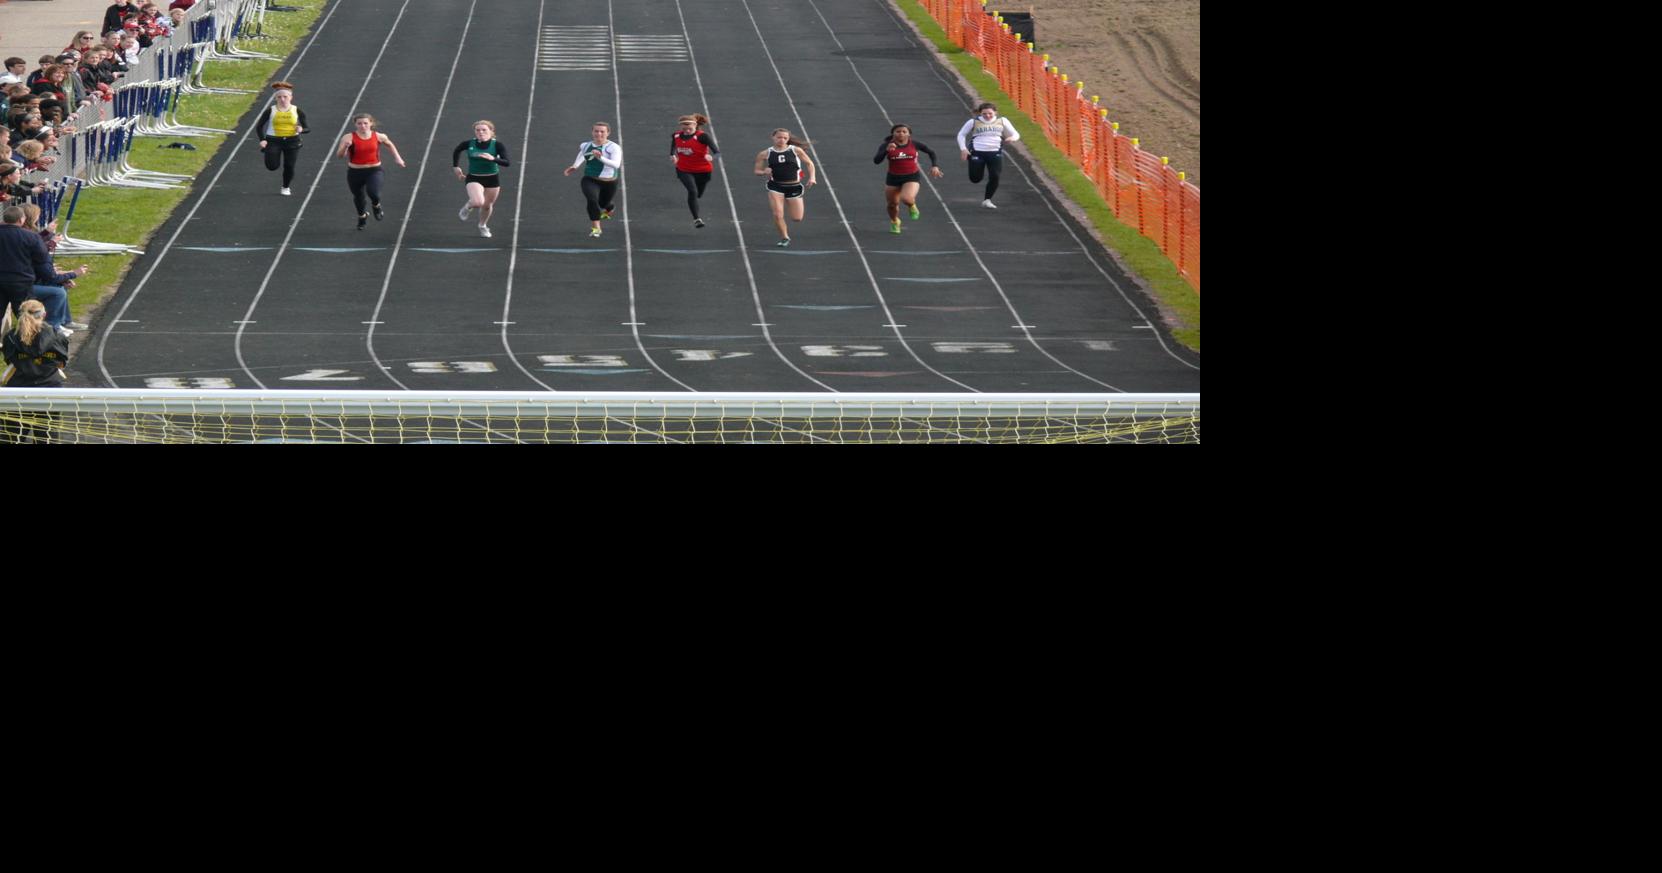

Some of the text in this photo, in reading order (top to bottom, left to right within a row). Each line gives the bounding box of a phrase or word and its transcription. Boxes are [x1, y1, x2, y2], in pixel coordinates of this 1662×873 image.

[778, 154, 786, 163] C
[801, 345, 889, 357] 3
[280, 368, 365, 382] 7
